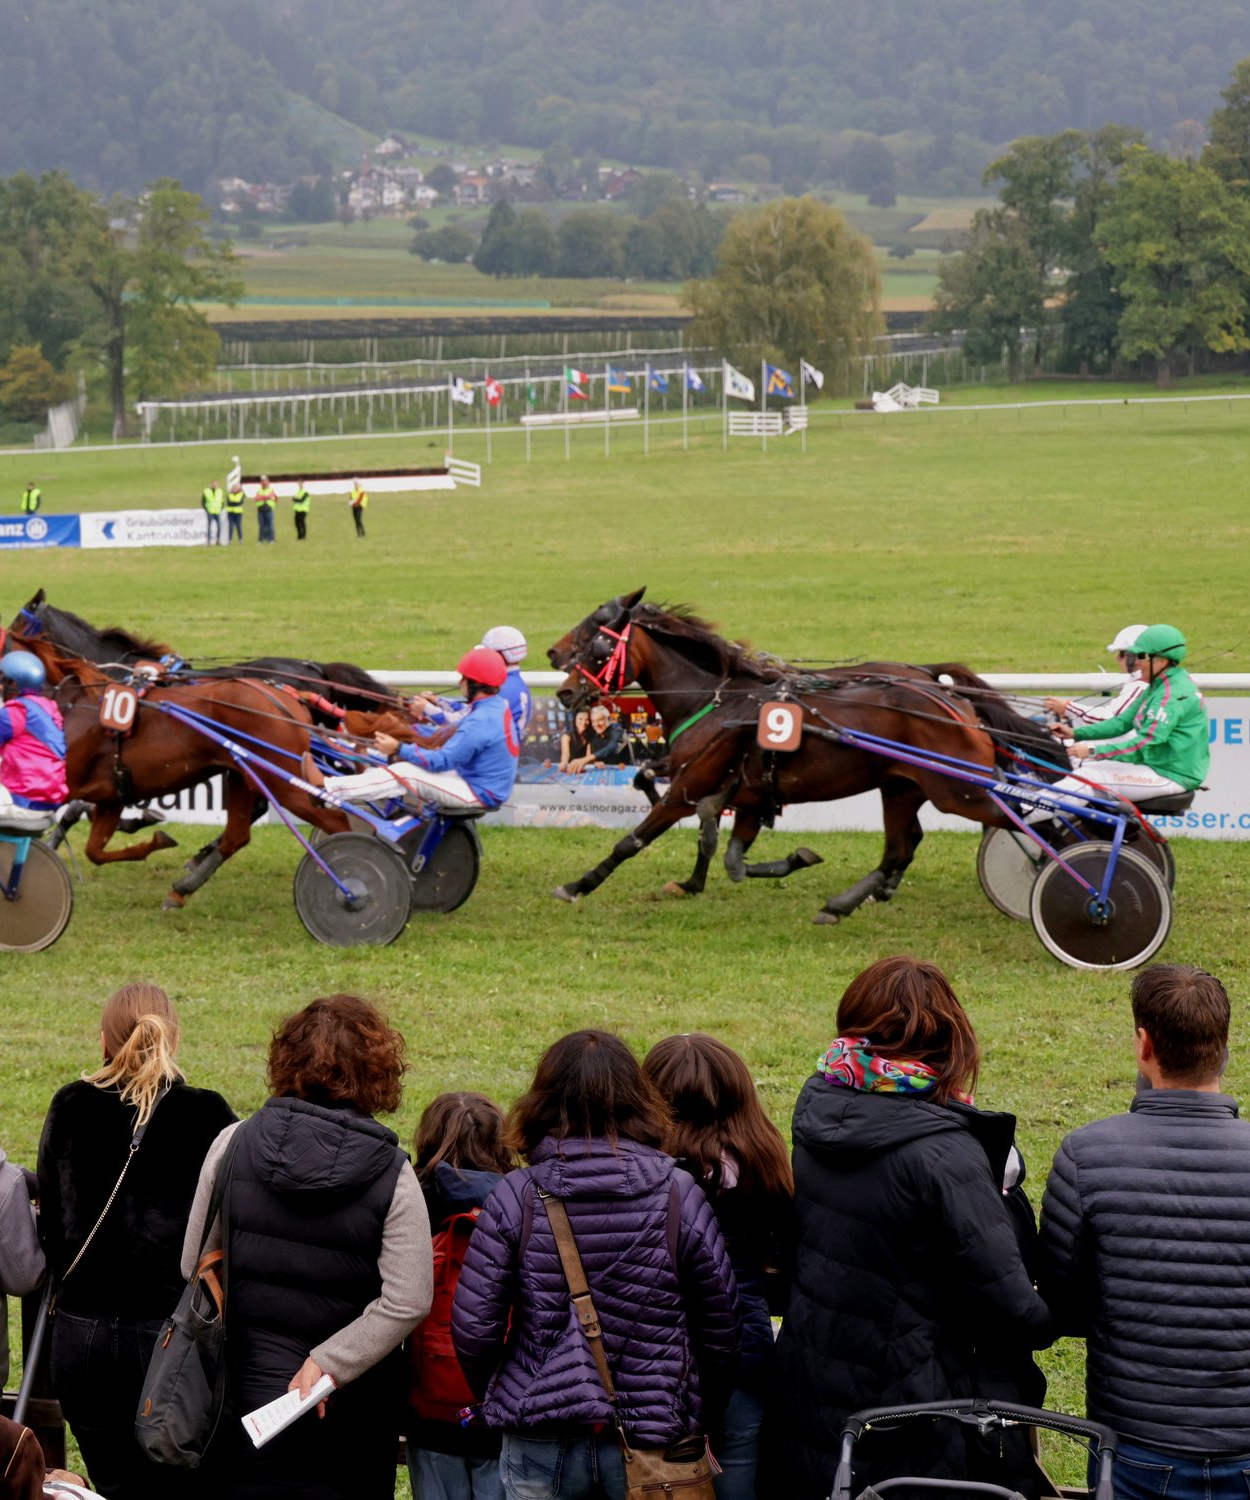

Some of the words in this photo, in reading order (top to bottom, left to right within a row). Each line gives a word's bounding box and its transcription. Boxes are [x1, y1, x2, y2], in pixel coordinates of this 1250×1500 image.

[127, 529, 208, 541] Kantonalban
[104, 689, 136, 725] 10
[766, 708, 794, 743] 9
